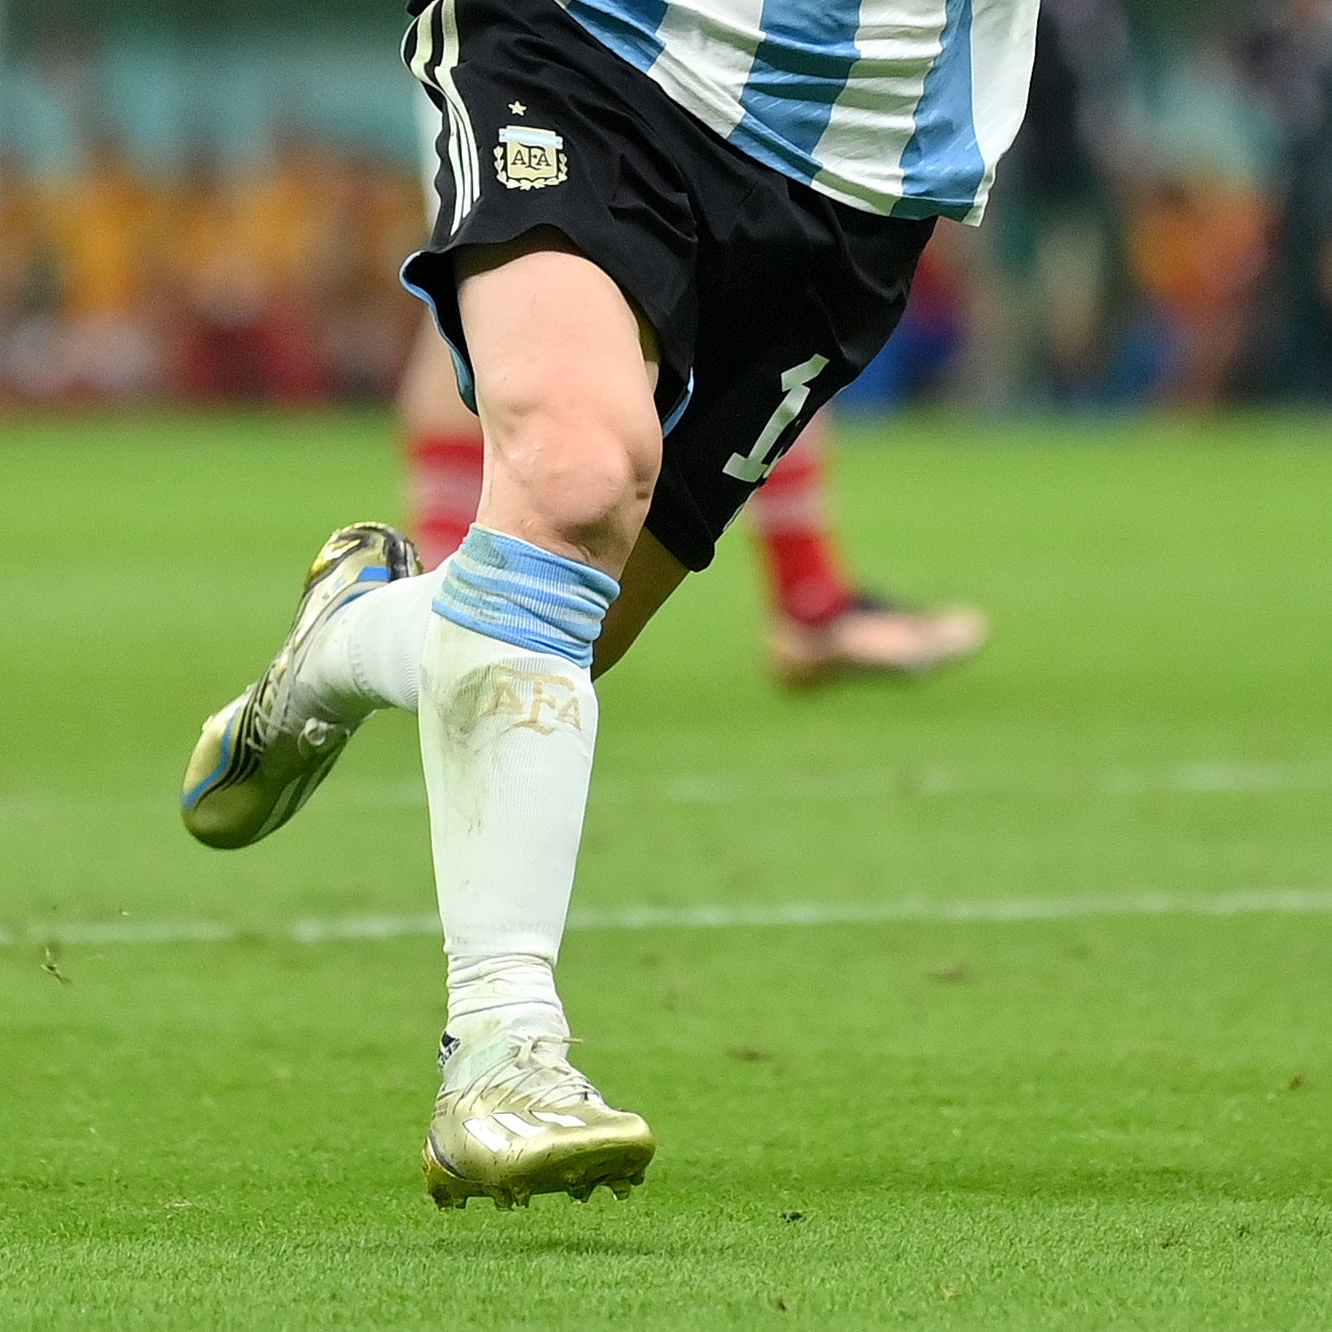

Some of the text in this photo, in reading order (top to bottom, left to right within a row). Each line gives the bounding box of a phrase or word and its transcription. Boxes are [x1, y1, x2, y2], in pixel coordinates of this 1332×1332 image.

[511, 142, 551, 171] AFA
[722, 353, 830, 483] 1
[479, 664, 582, 736] AFA
